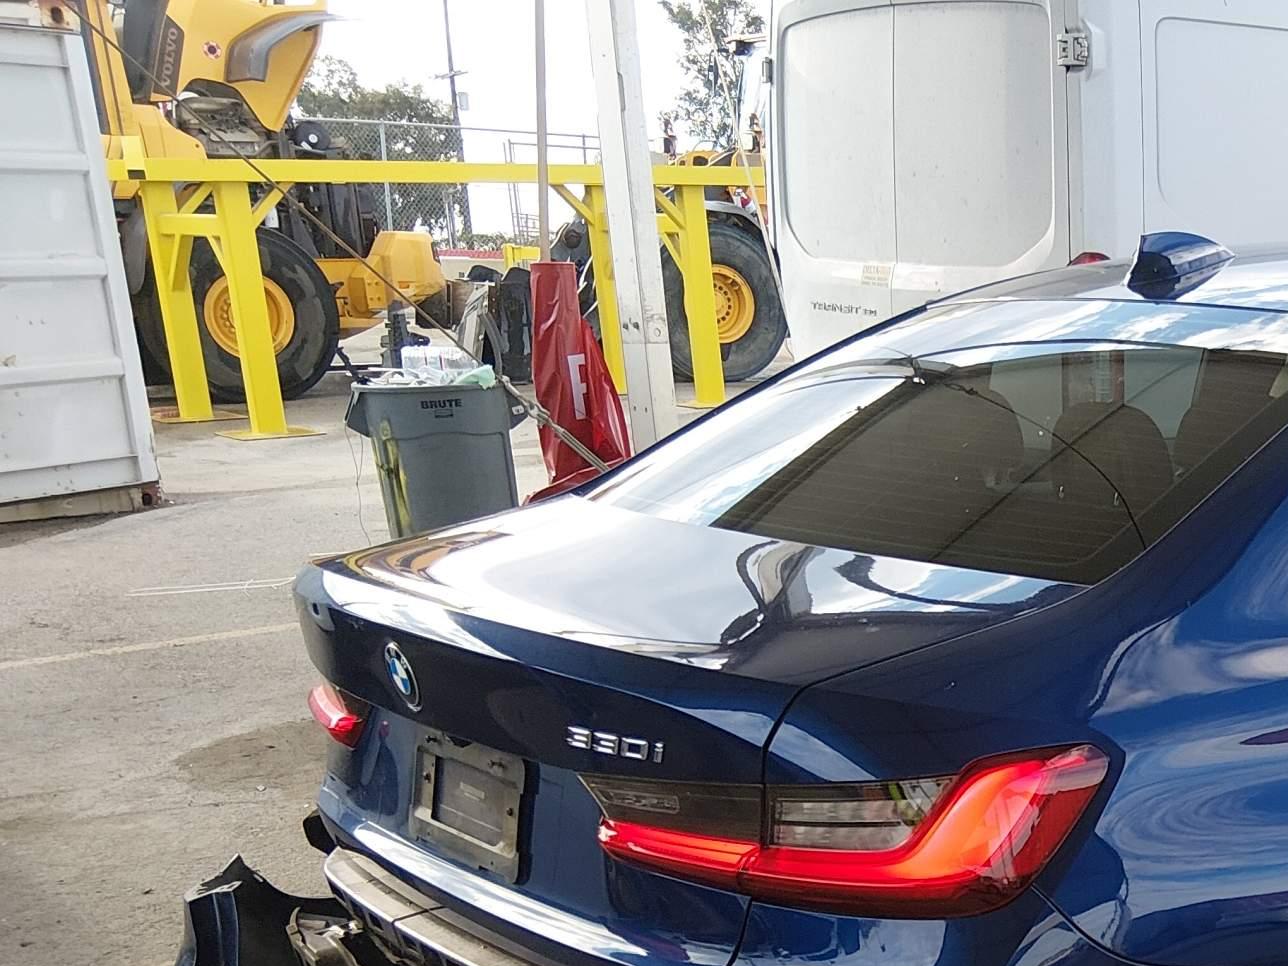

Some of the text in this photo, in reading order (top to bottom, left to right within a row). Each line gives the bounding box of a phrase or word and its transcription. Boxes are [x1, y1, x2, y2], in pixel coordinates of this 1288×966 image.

[160, 27, 178, 87] VOLVO
[420, 398, 463, 410] BRUTE
[565, 726, 665, 764] 330i
